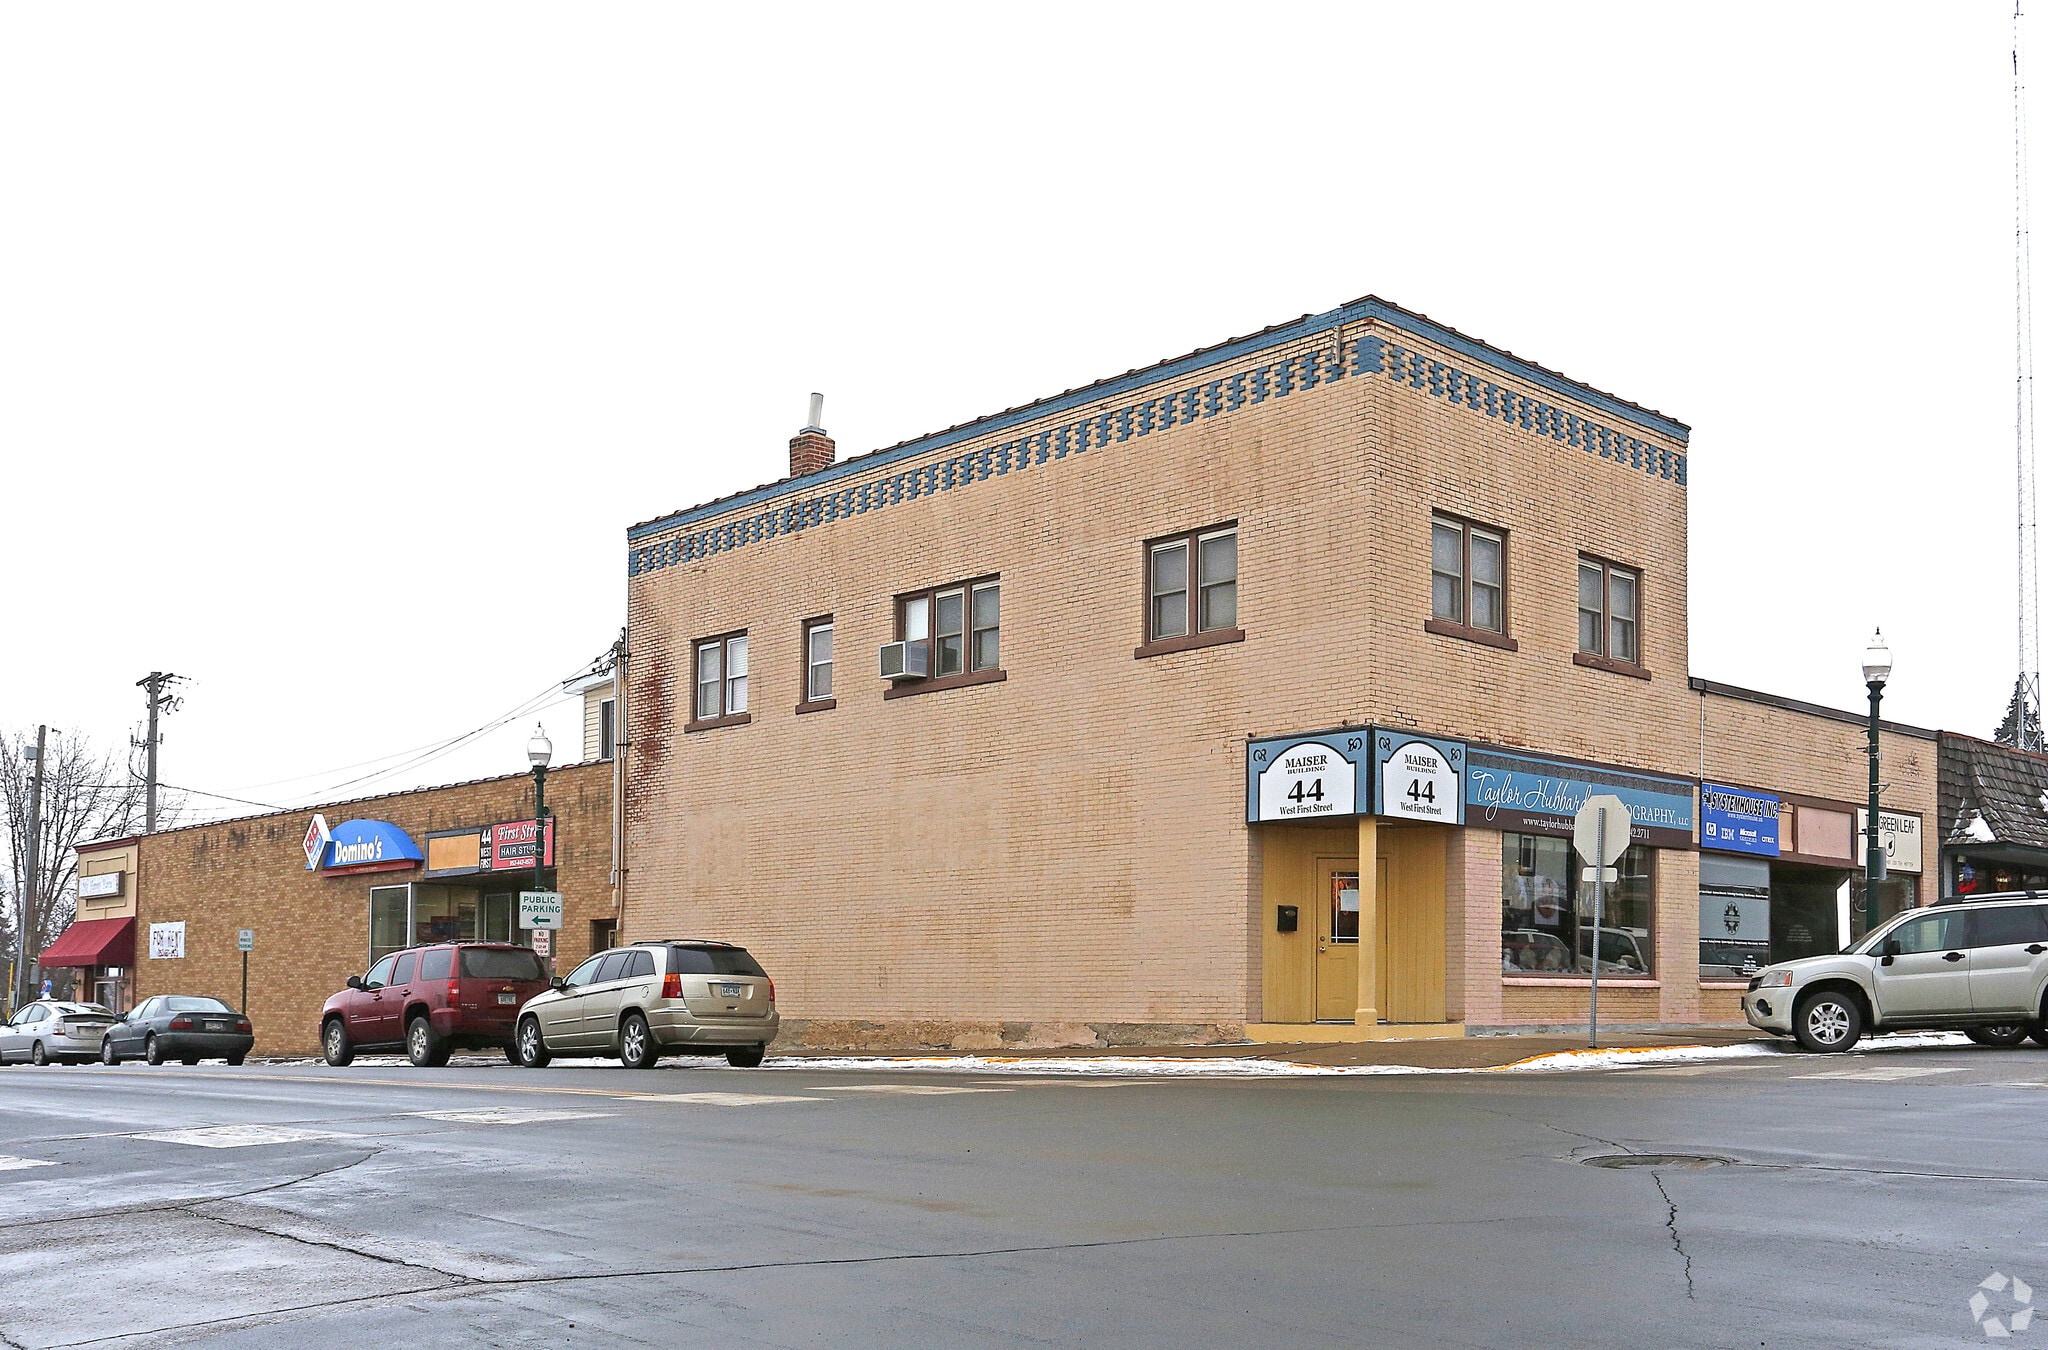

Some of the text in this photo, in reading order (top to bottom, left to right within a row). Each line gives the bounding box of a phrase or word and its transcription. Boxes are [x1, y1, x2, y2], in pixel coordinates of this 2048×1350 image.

[1285, 754, 1328, 769] MAISER
[1404, 754, 1438, 768] MAISER
[1287, 766, 1326, 775] BUILDING
[1406, 765, 1437, 775] BUILDING
[1287, 778, 1325, 804] 44
[1406, 778, 1436, 804] 44
[1471, 770, 1523, 822] Taylor
[1523, 779, 1593, 813] Hubbard
[1678, 817, 1689, 826] LLC
[1279, 803, 1333, 815] West First Street
[1400, 802, 1442, 815] West First Street
[1711, 791, 1778, 820] SYSTEMHOUSE INC.
[481, 829, 492, 845] 44
[497, 825, 520, 841] First
[1721, 827, 1735, 841] IBM
[334, 835, 383, 864] Domino's
[480, 846, 492, 858] WEST
[501, 845, 536, 857] HAIR STUD
[480, 857, 492, 869] FIRST
[523, 896, 556, 904] PUBLIC
[521, 905, 561, 914] PARKING
